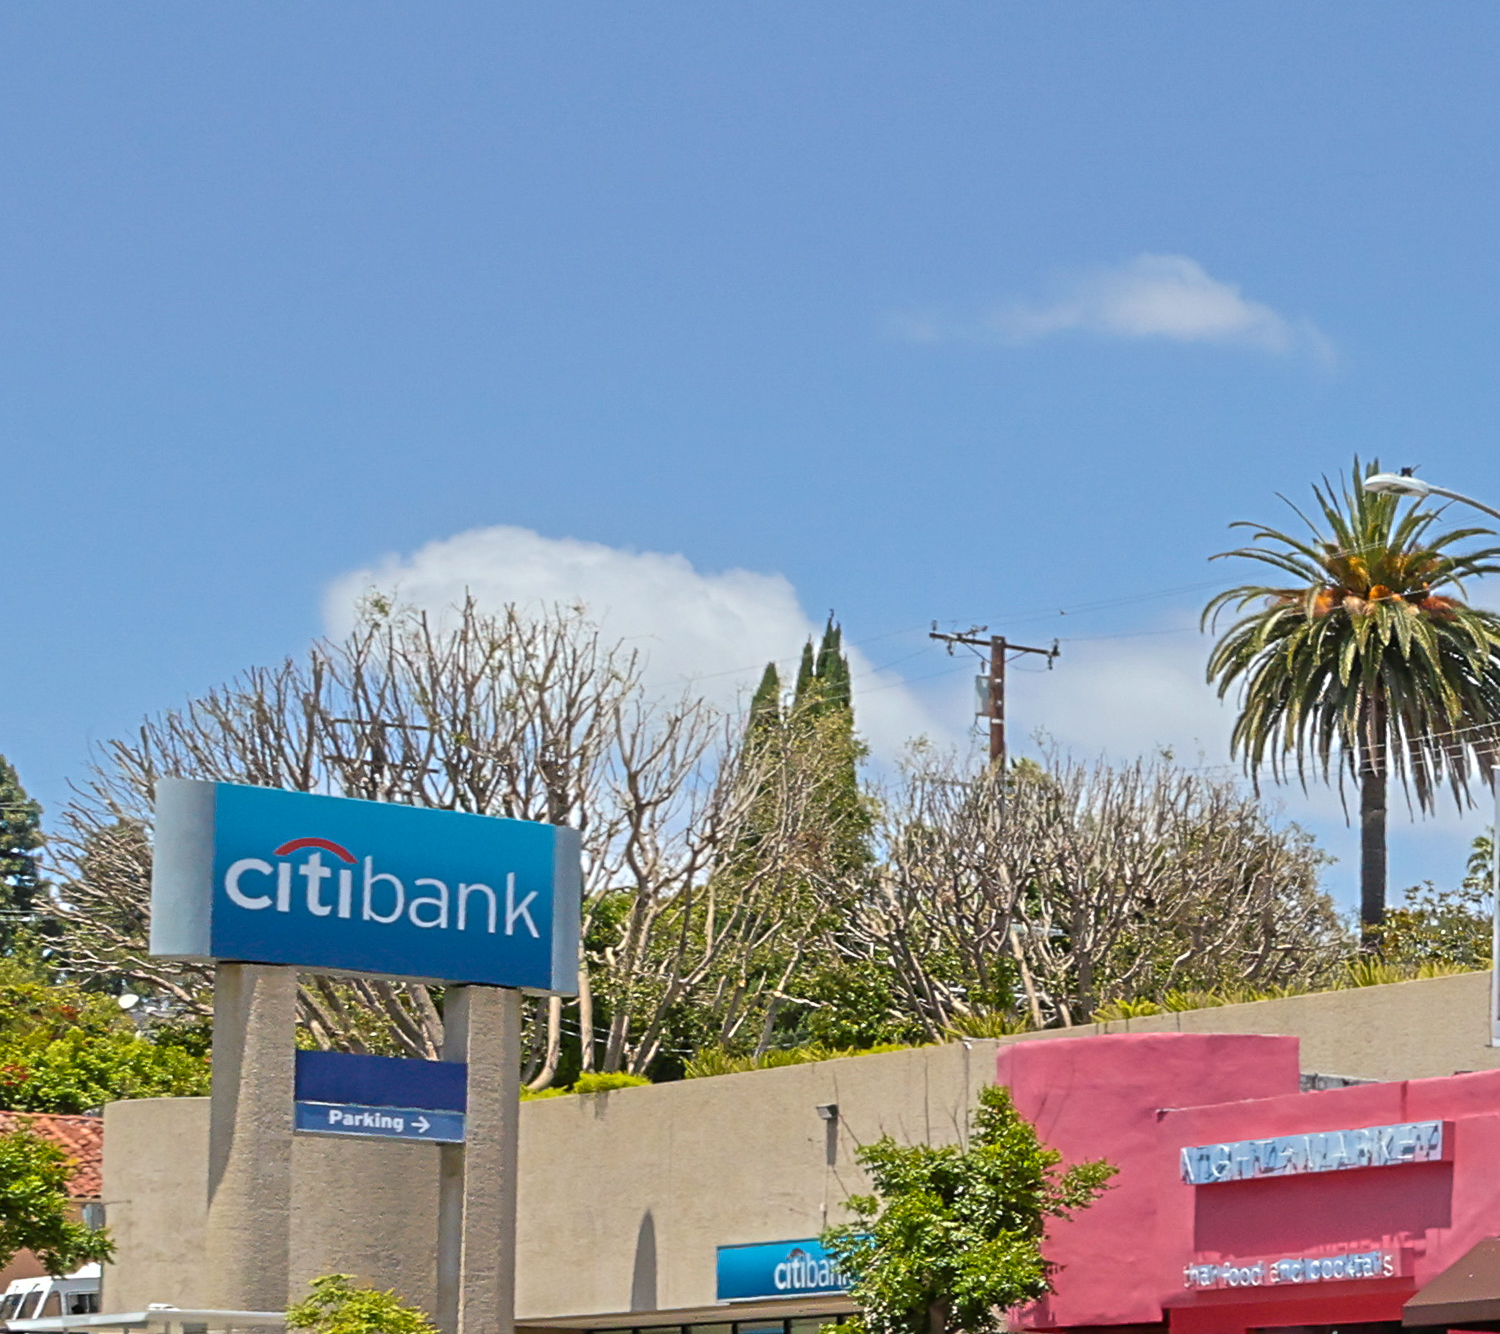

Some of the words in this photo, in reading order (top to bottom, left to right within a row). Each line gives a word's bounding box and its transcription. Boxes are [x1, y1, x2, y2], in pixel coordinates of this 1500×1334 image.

[224, 851, 540, 939] citibank
[328, 1109, 405, 1133] Parking
[1223, 1260, 1265, 1286] food
